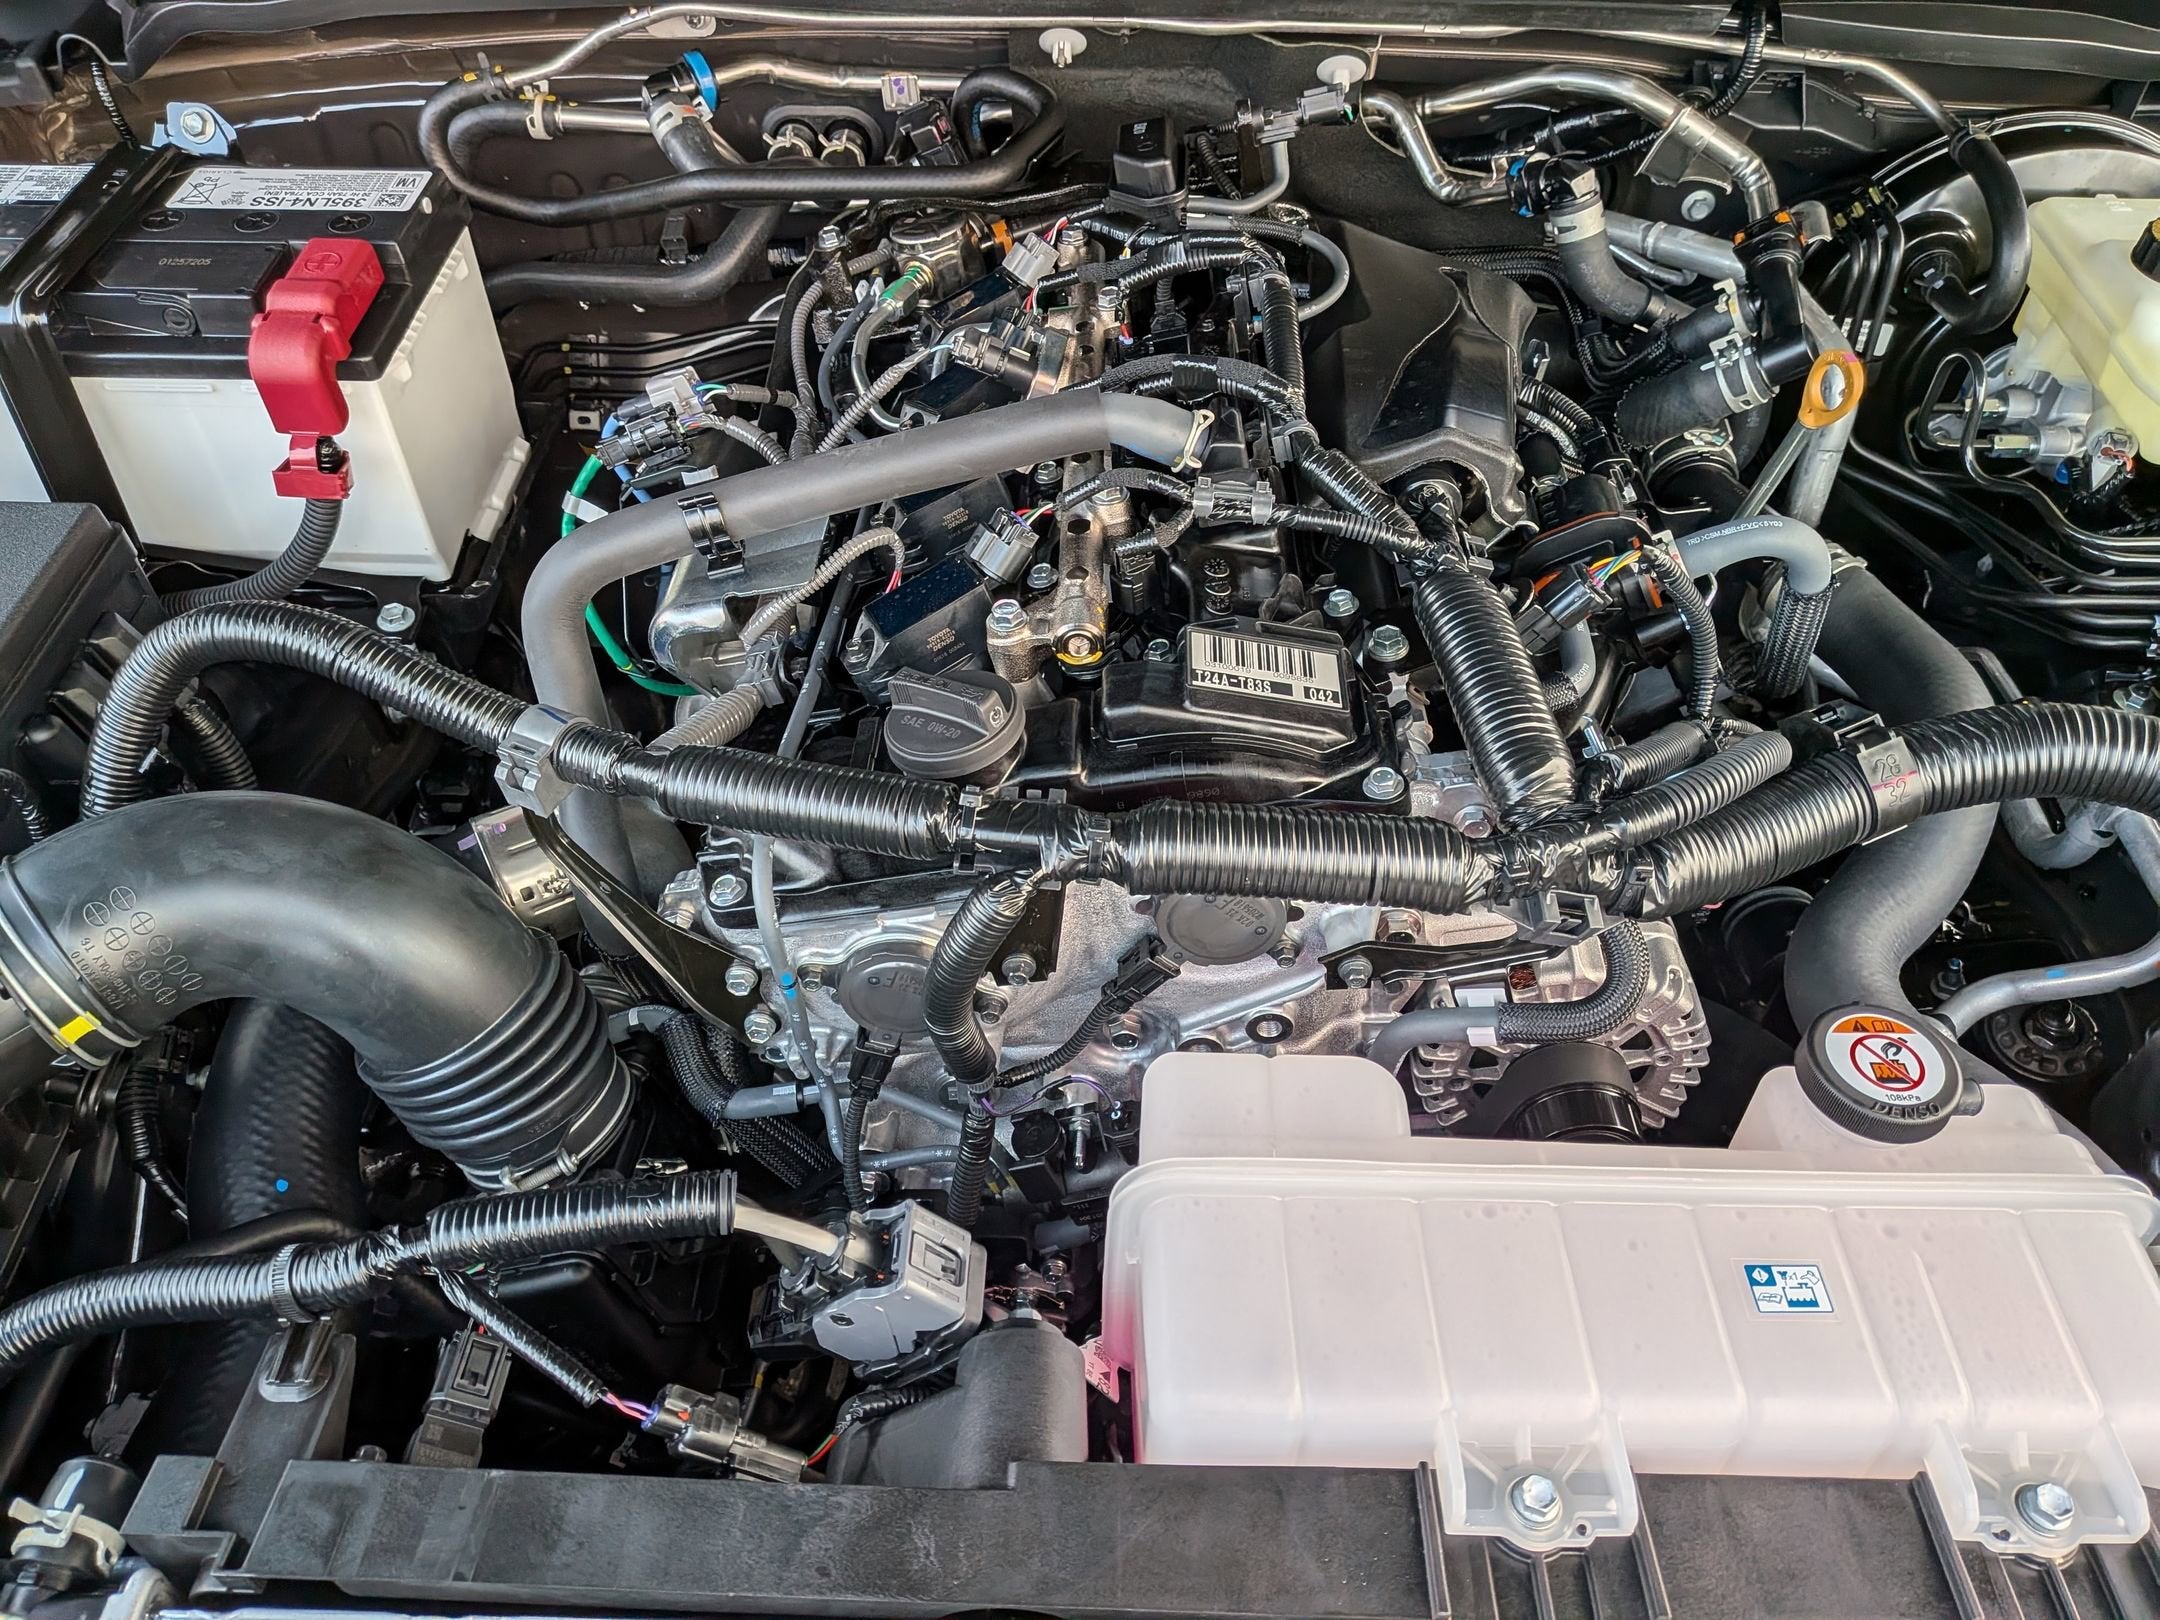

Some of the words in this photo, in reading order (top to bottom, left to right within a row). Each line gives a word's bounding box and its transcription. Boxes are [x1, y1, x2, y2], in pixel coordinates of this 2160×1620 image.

[396, 177, 416, 188] VM
[249, 195, 368, 208] 395LN4-ISS
[1195, 670, 1273, 694] T24A-T83S
[1309, 688, 1334, 703] 042
[900, 714, 926, 728] SAE
[927, 720, 962, 740] 0W-20
[1872, 753, 1902, 783] 28
[1883, 777, 1913, 808] 32
[1885, 1093, 1922, 1102] 108kPa
[1871, 1102, 1941, 1120] DENSO
